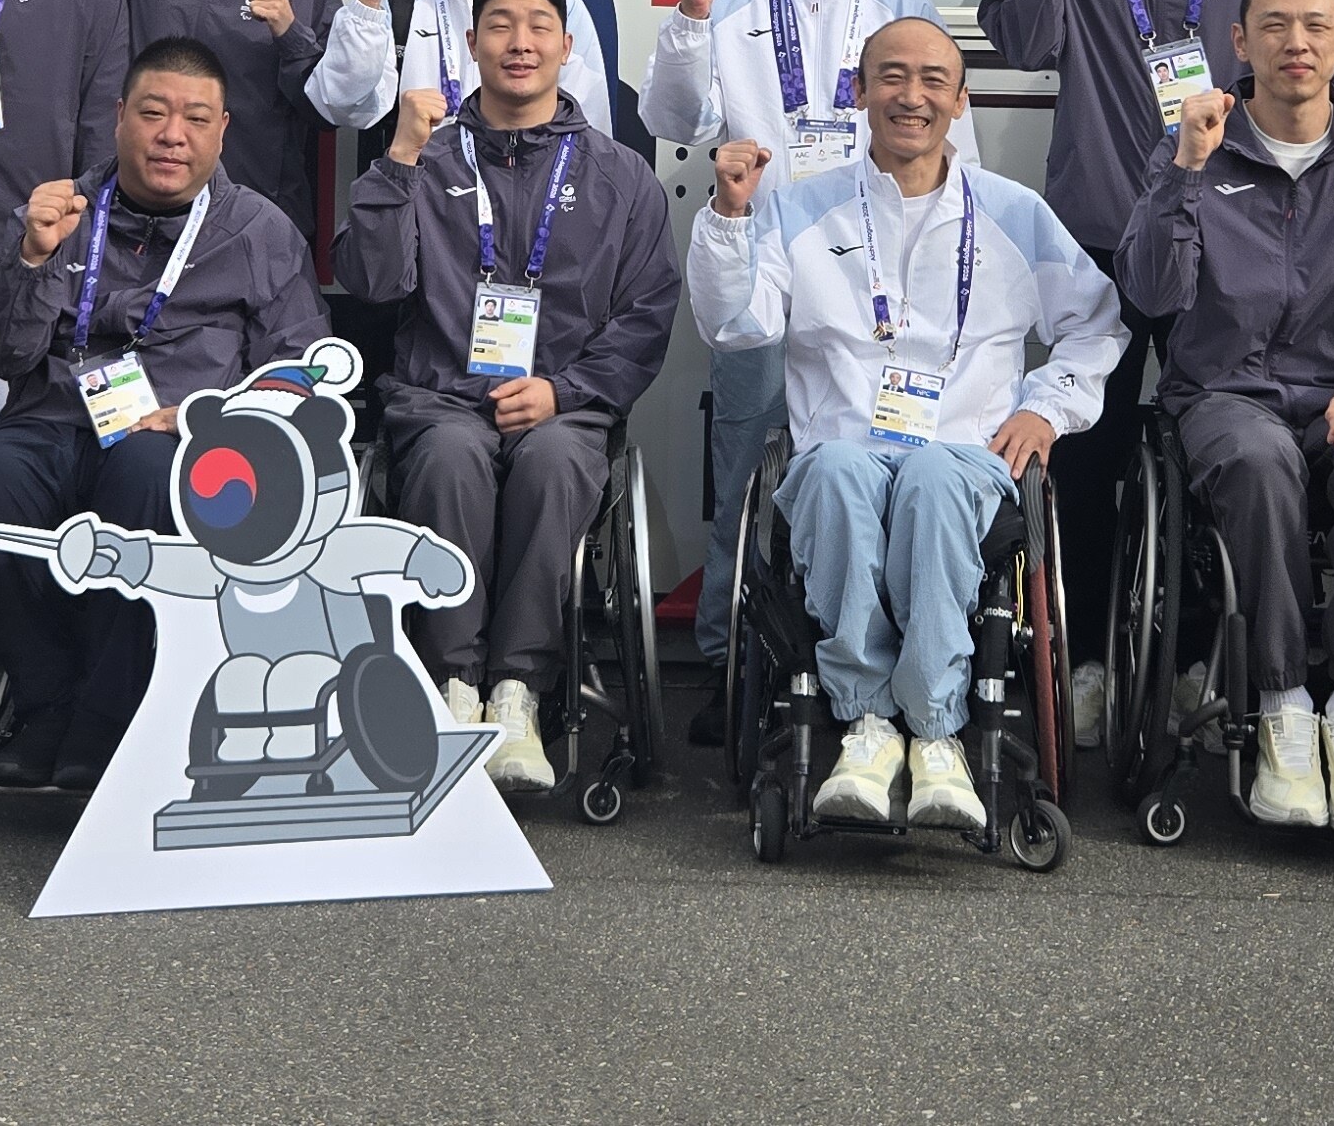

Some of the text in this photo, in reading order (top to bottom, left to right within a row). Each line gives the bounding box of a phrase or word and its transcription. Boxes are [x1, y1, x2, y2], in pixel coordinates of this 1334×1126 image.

[794, 151, 809, 159] AAC
[916, 389, 931, 397] NPC
[873, 428, 886, 436] VIP
